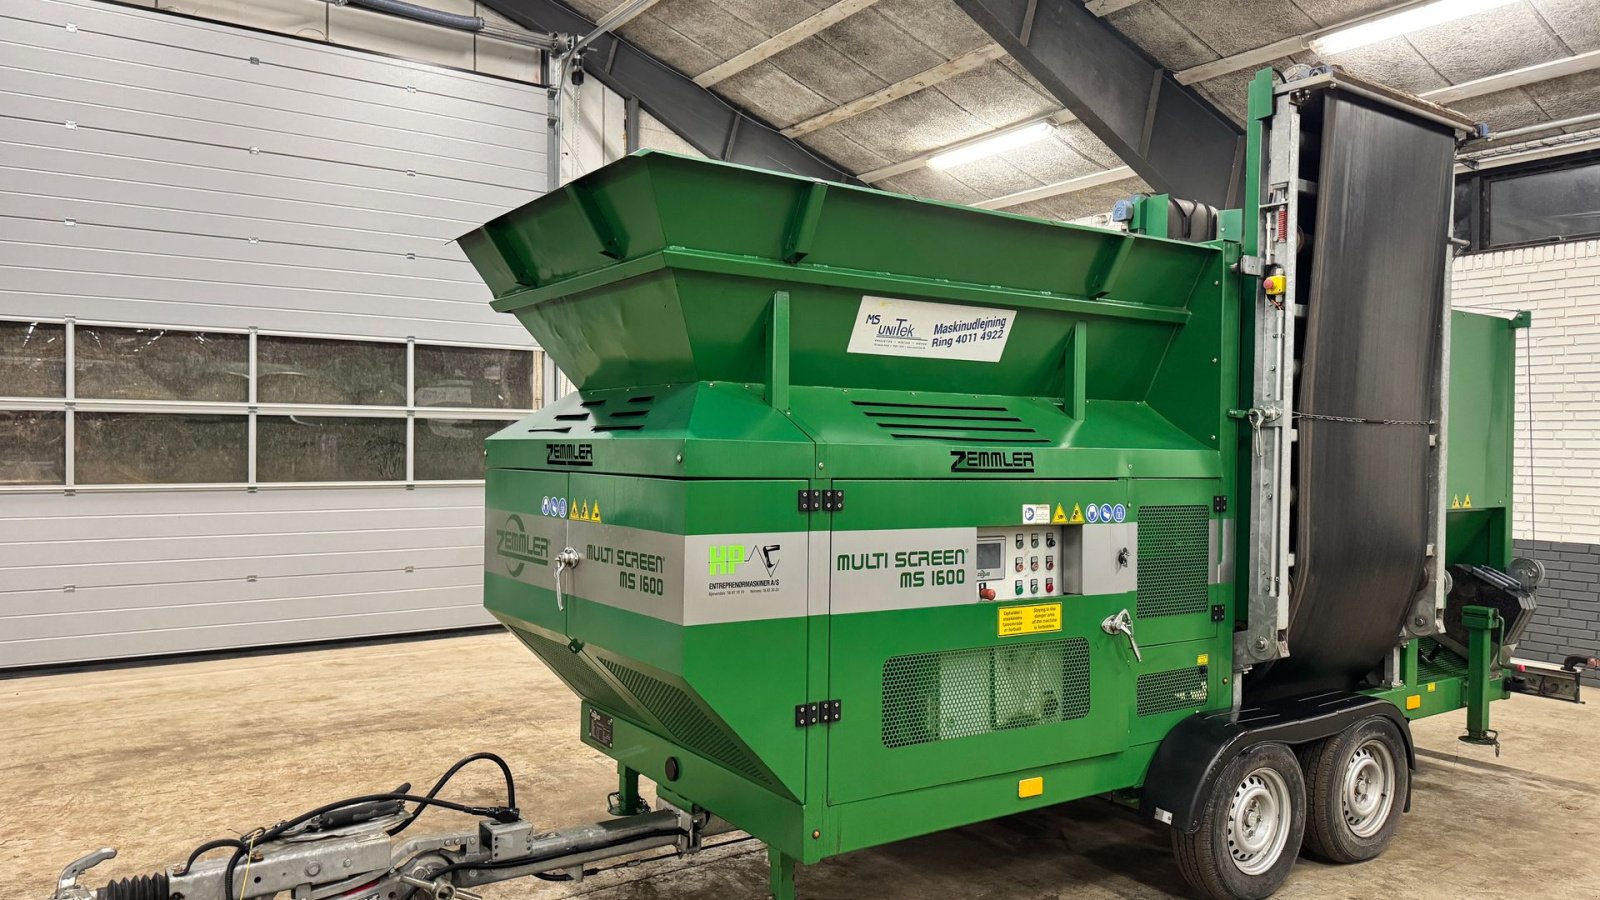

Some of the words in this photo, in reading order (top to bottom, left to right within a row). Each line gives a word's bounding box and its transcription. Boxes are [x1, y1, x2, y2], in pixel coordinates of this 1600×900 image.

[866, 314, 881, 325] MS
[934, 316, 1007, 336] Maskinudlejning
[931, 337, 953, 348] Ring
[955, 333, 978, 344] 4011
[980, 330, 1004, 341] 4922
[546, 443, 593, 467] ZEMMLER
[951, 451, 1035, 473] ZEMMLER
[586, 544, 614, 564] MULTI
[709, 544, 745, 576] HP
[837, 553, 889, 571] MULTI
[619, 571, 636, 590] MS
[639, 579, 664, 596] 1600
[900, 571, 925, 588] MS
[931, 569, 965, 586] 1600
